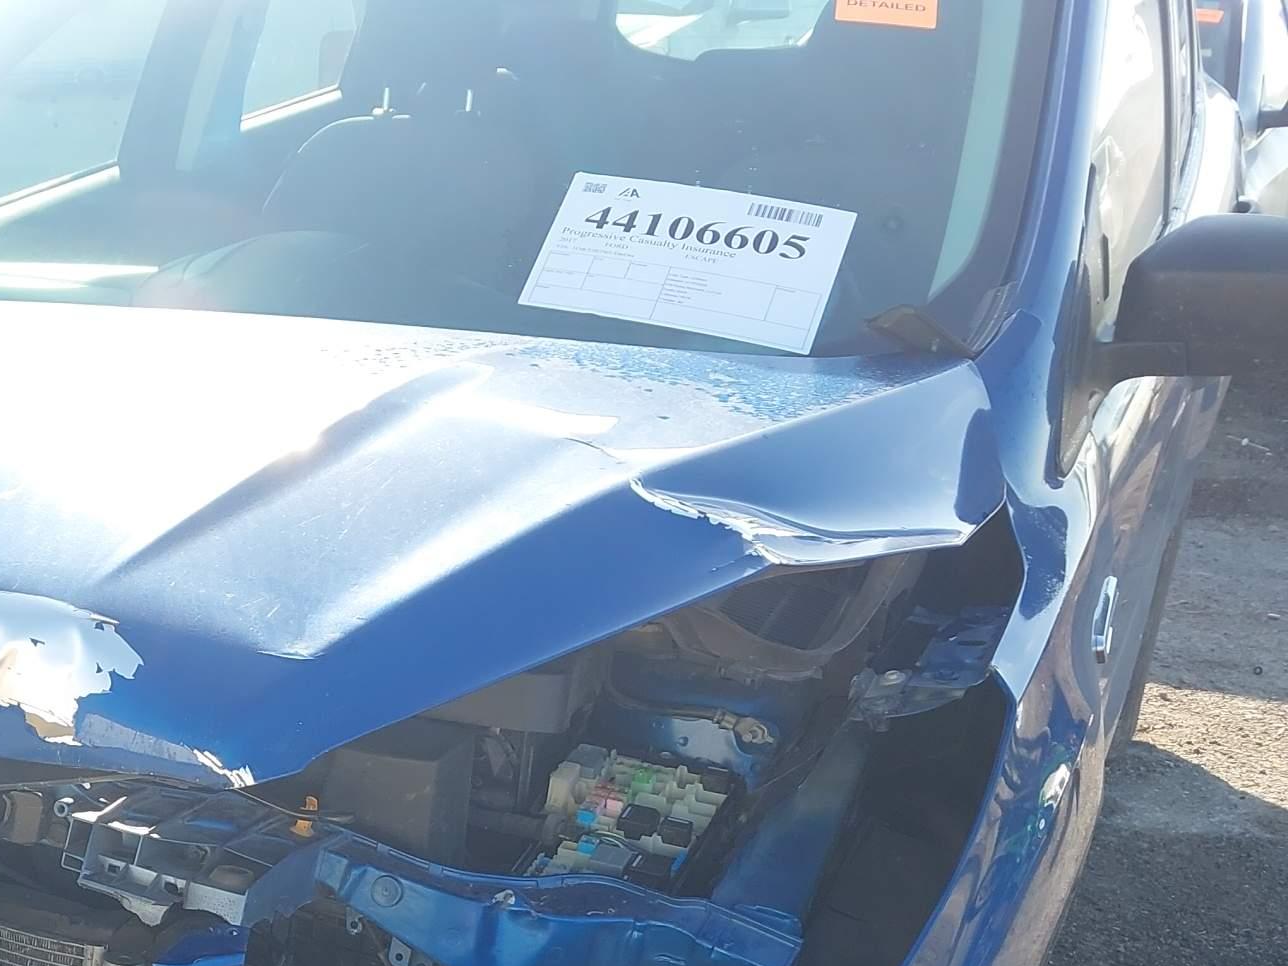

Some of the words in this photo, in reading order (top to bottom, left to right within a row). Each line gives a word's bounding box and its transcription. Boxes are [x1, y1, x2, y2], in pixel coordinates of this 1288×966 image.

[847, 0, 926, 12] DETAILED
[562, 226, 626, 242] Progressive
[629, 235, 679, 250] Casualty
[681, 243, 737, 258] Insurance
[584, 205, 811, 261] 44106605
